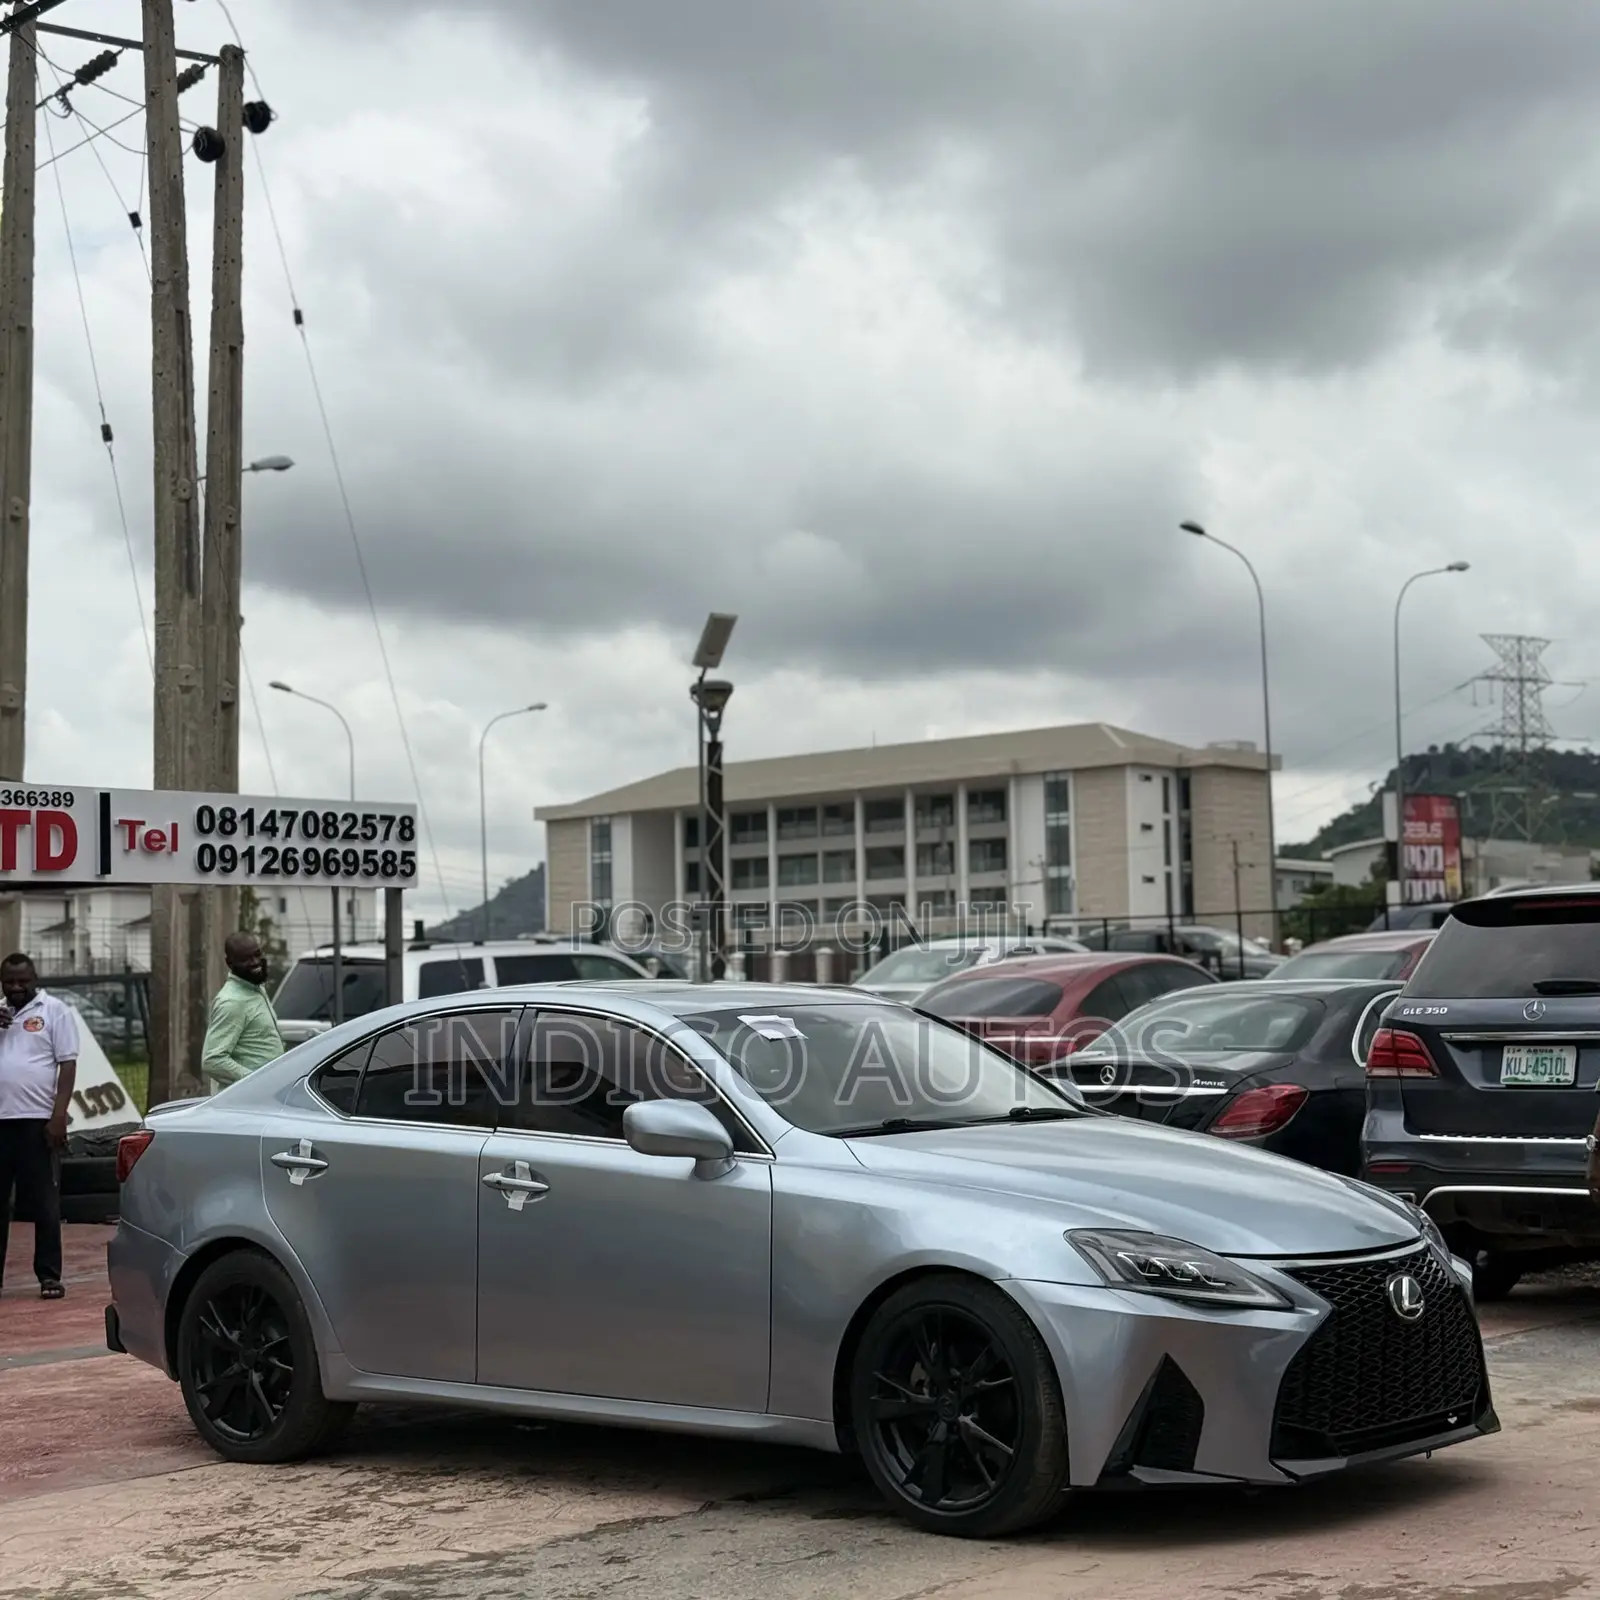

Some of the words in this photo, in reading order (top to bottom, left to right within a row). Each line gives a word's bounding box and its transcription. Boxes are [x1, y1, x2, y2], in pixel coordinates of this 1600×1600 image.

[0, 789, 75, 808] 366389
[0, 809, 78, 871] TD
[117, 818, 179, 853] Tel
[197, 804, 416, 842] 08147082578
[198, 843, 417, 878] 09126969585
[1403, 1007, 1424, 1015] GLE
[1424, 1006, 1448, 1015] 350
[73, 1081, 126, 1119] LTD
